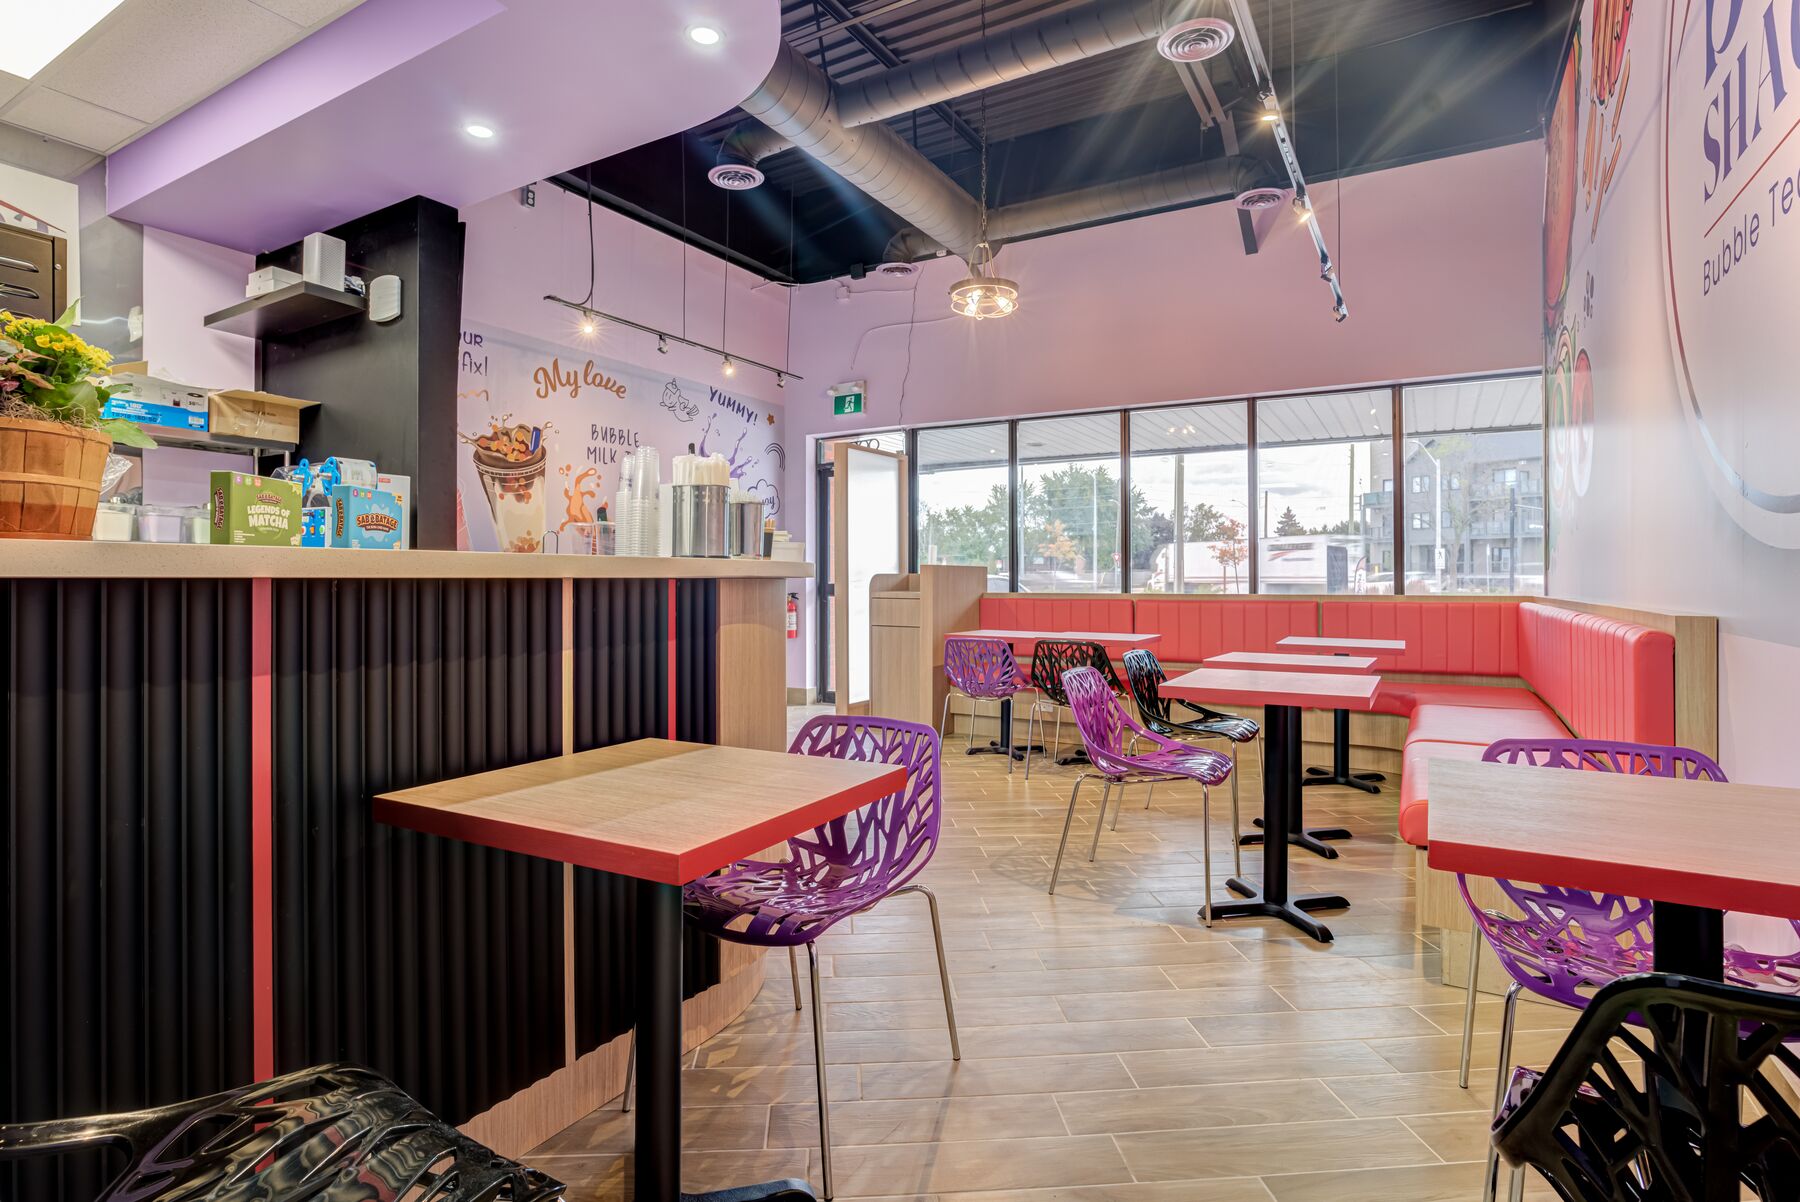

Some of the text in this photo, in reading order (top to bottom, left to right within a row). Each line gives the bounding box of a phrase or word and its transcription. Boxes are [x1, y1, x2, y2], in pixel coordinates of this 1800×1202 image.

[1704, 168, 1800, 297] Bubble Te
[459, 332, 483, 348] UR
[462, 351, 488, 377] fix!
[533, 358, 627, 399] My love
[709, 386, 758, 426] YUMMY!
[591, 423, 640, 448] BUBBLE
[587, 446, 617, 465] MILK
[247, 505, 291, 518] LEGENDS OF
[248, 514, 289, 530] MATCHA
